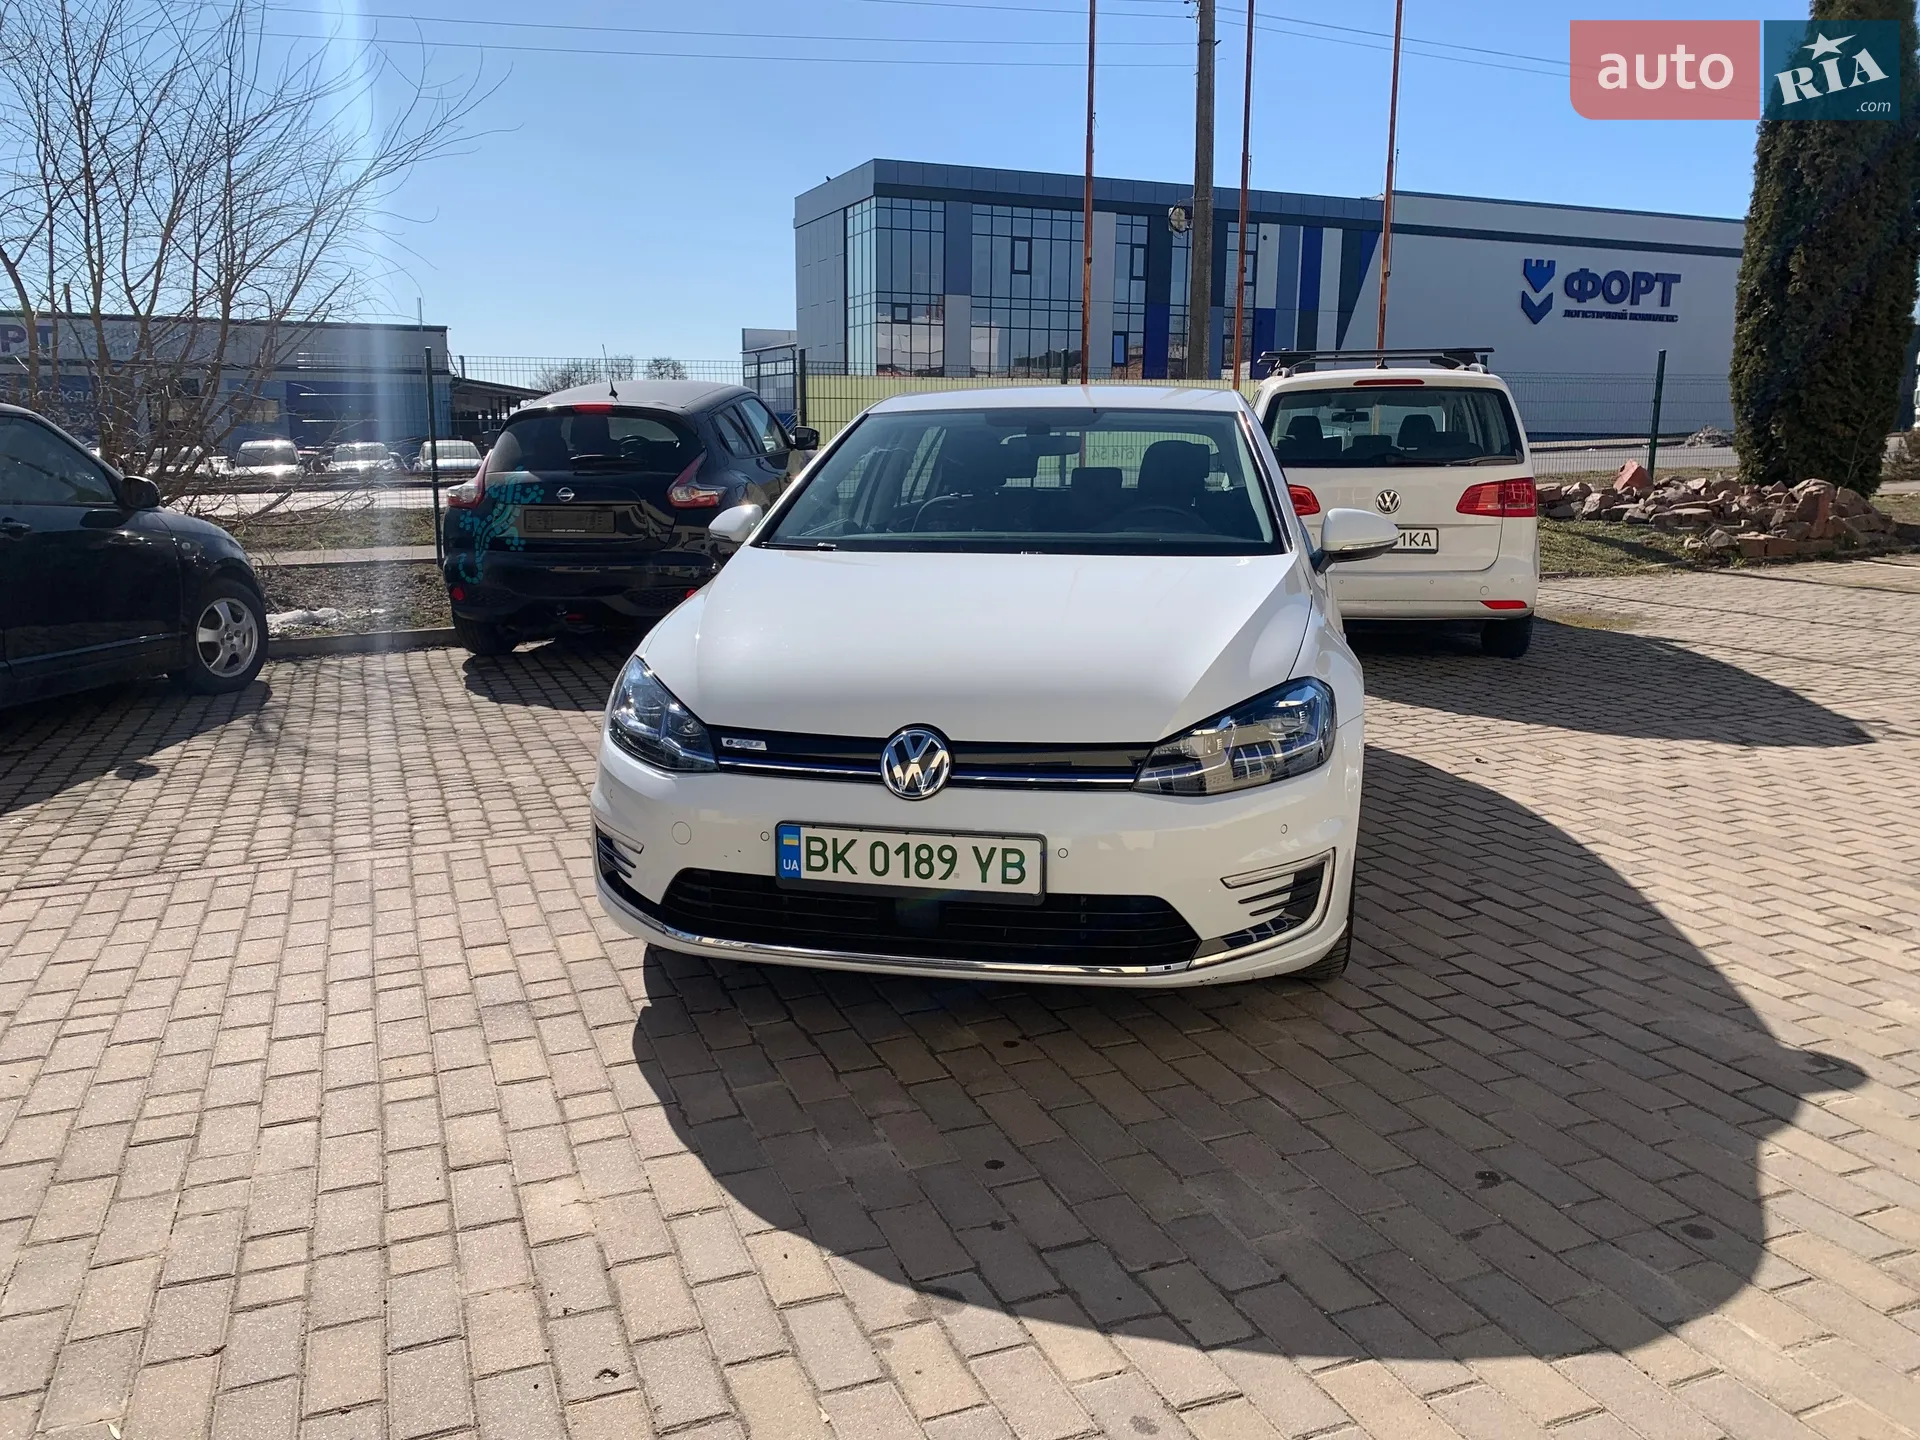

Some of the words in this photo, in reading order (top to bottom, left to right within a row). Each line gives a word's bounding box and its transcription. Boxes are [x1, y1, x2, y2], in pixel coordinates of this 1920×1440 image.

[1564, 268, 1681, 307] ФОРТ
[783, 859, 799, 871] UA
[805, 836, 858, 875] BK
[869, 841, 958, 880] 0189
[972, 846, 1026, 884] YB
